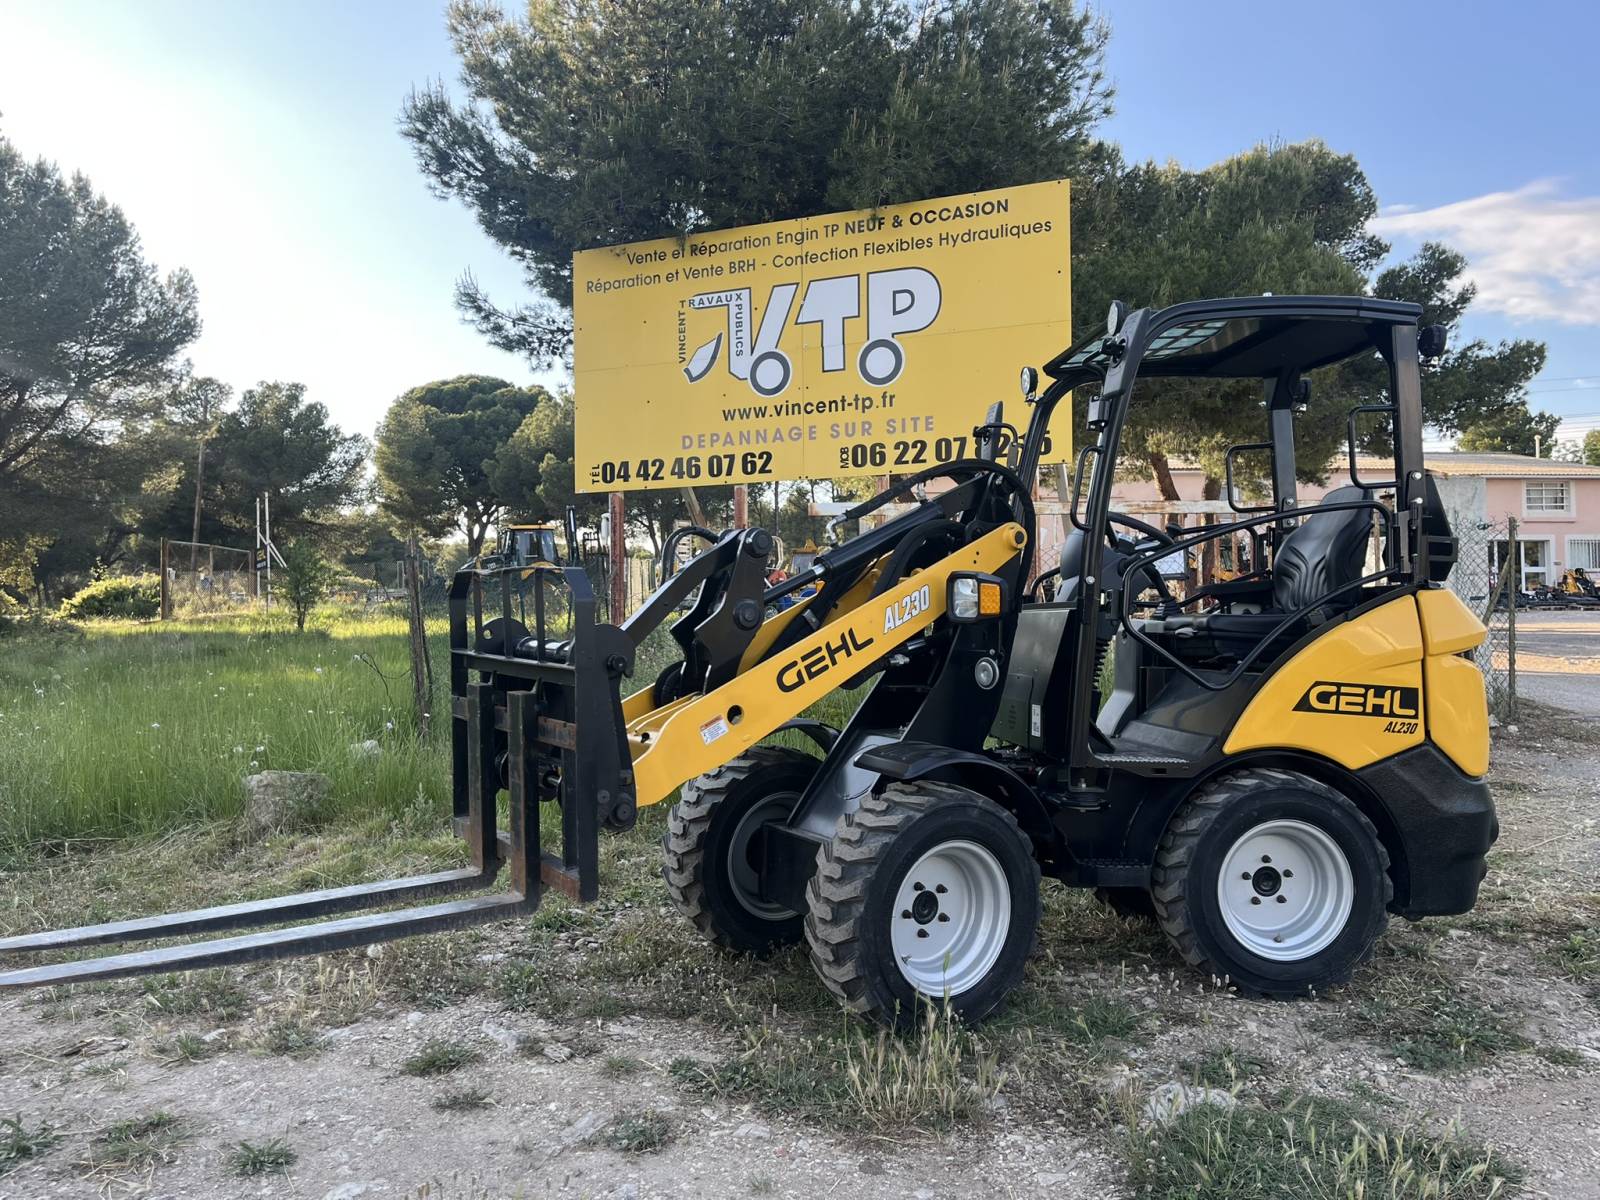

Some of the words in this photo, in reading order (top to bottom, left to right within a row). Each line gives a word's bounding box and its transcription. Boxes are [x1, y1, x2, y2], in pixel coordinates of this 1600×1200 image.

[627, 249, 667, 265] Vente
[691, 236, 771, 257] Réparation
[777, 227, 819, 246] Engin
[824, 223, 840, 238] TP
[845, 216, 886, 236] NEUF
[892, 214, 903, 229] &
[910, 199, 1009, 226] OCCASION
[586, 272, 661, 294] Réparation
[666, 269, 679, 283] et
[683, 264, 724, 281] Vente
[729, 259, 756, 275] BRH
[773, 245, 858, 270] Confection
[864, 235, 933, 257] Flexibles
[939, 220, 1052, 248] Hydrauliques
[680, 292, 743, 308] TRAVAUX
[678, 311, 687, 364] VINCENT
[735, 303, 744, 357] PUBLICS
[722, 391, 896, 422] www.vincent-tp.fr
[681, 424, 817, 450] DEPANNAGE
[830, 420, 873, 440] SUR
[886, 415, 934, 435] SITE
[601, 461, 631, 484] 04
[636, 458, 665, 481] 42
[670, 456, 701, 479] 46
[708, 454, 736, 478] 07
[741, 451, 773, 475] 62
[839, 446, 850, 469] MOB
[851, 442, 887, 468] 06
[893, 440, 928, 465] 22
[935, 437, 968, 462] 07
[883, 584, 930, 635] AL230
[776, 627, 874, 693] GEHL
[1309, 684, 1416, 716] GEHL
[1383, 721, 1419, 735] AL230
